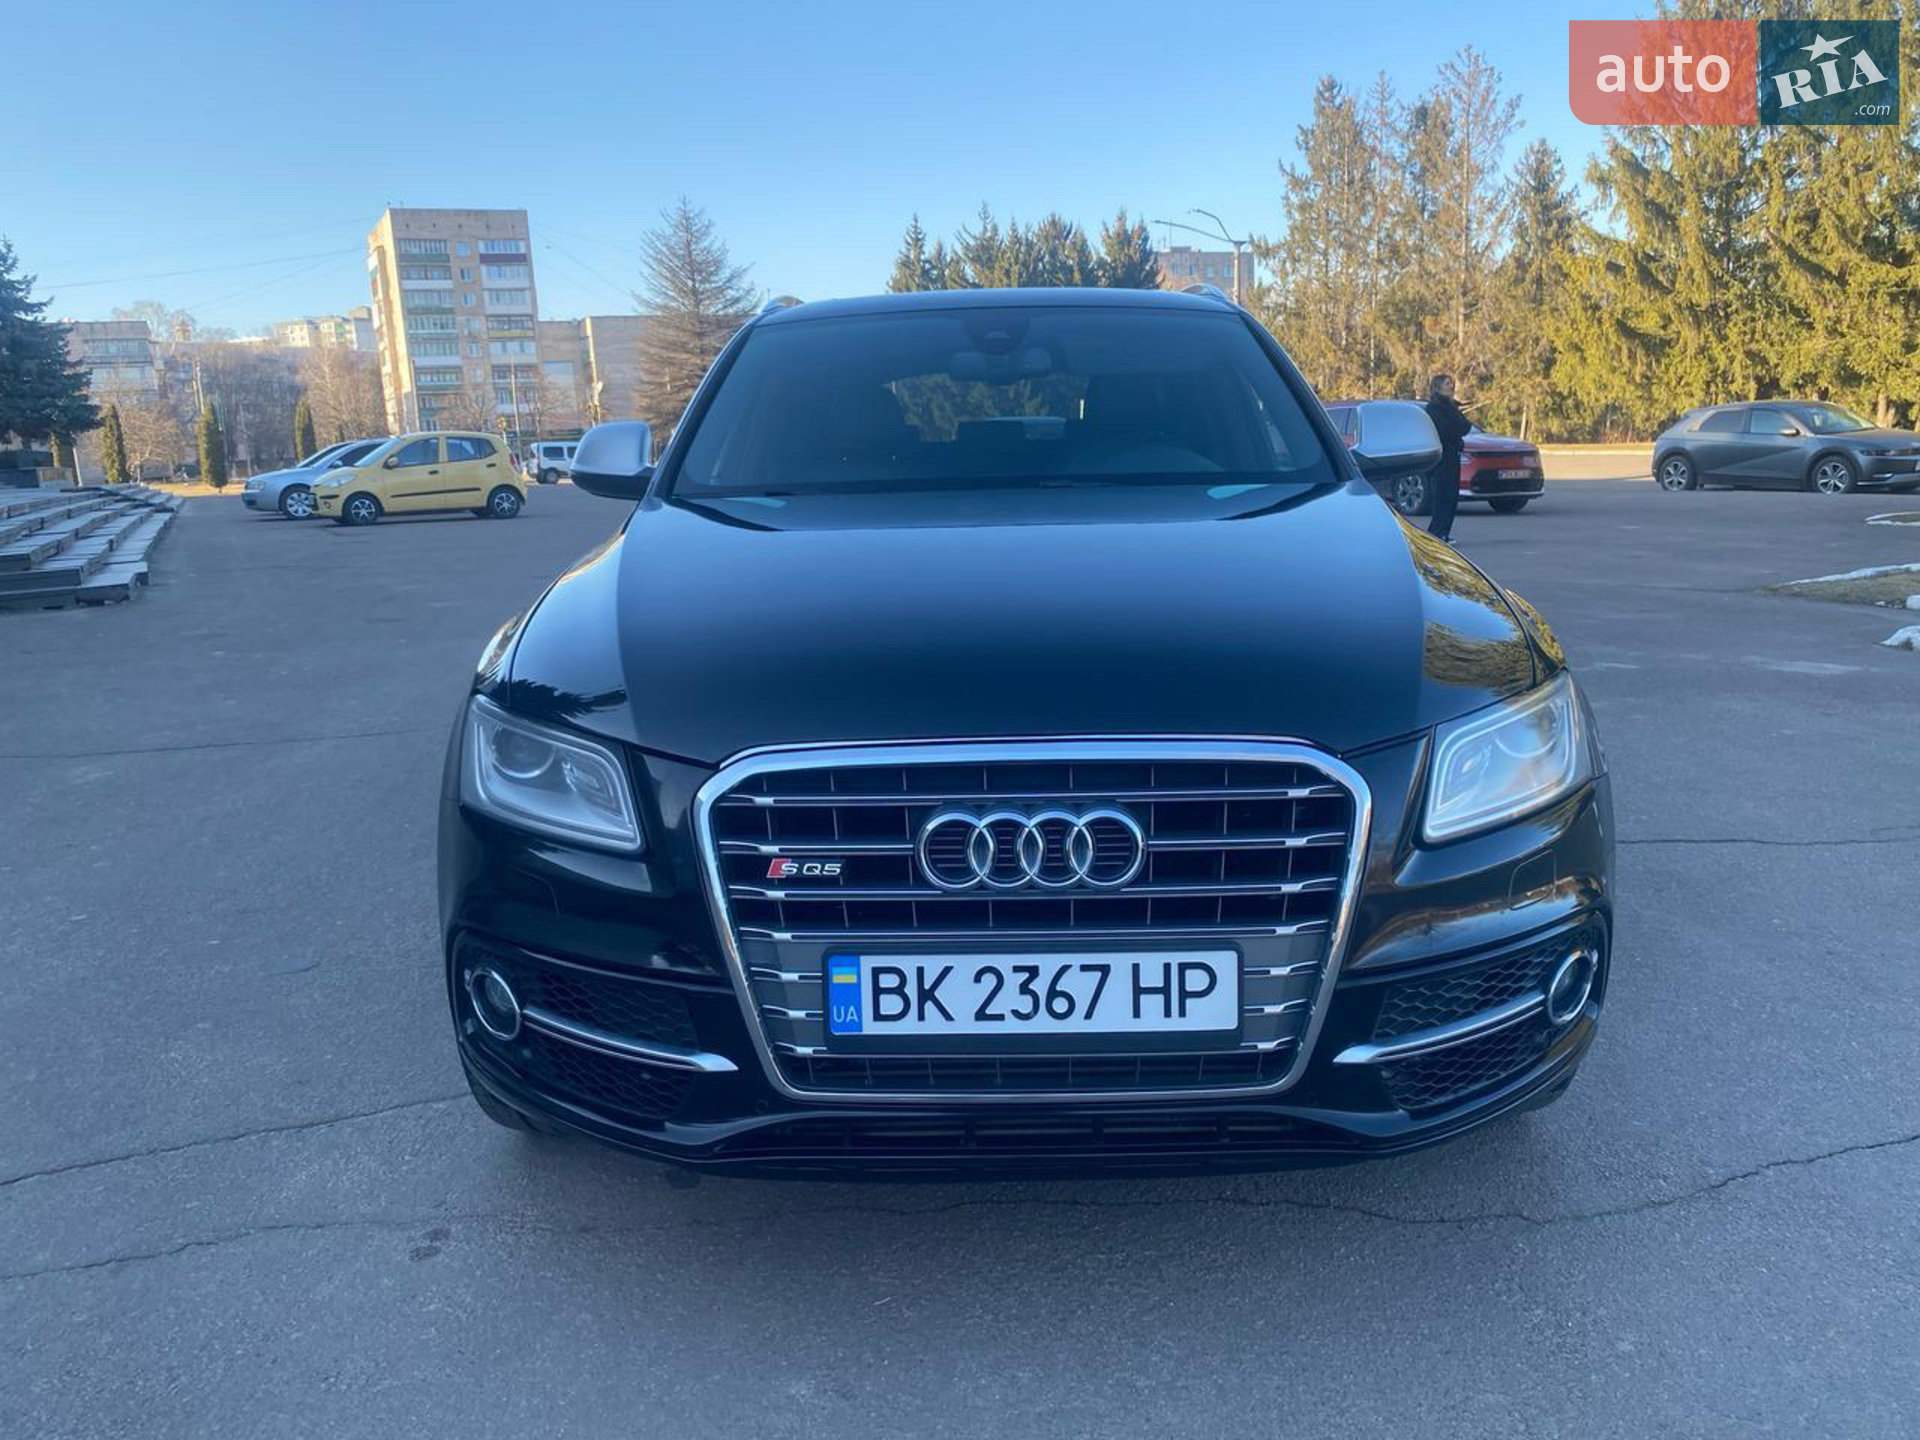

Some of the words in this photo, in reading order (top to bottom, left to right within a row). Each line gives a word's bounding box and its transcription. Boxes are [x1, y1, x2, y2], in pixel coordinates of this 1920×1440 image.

[871, 965, 955, 1022] BK
[973, 963, 1111, 1022] 2367
[1131, 961, 1218, 1019] HP
[833, 1005, 859, 1023] UA
